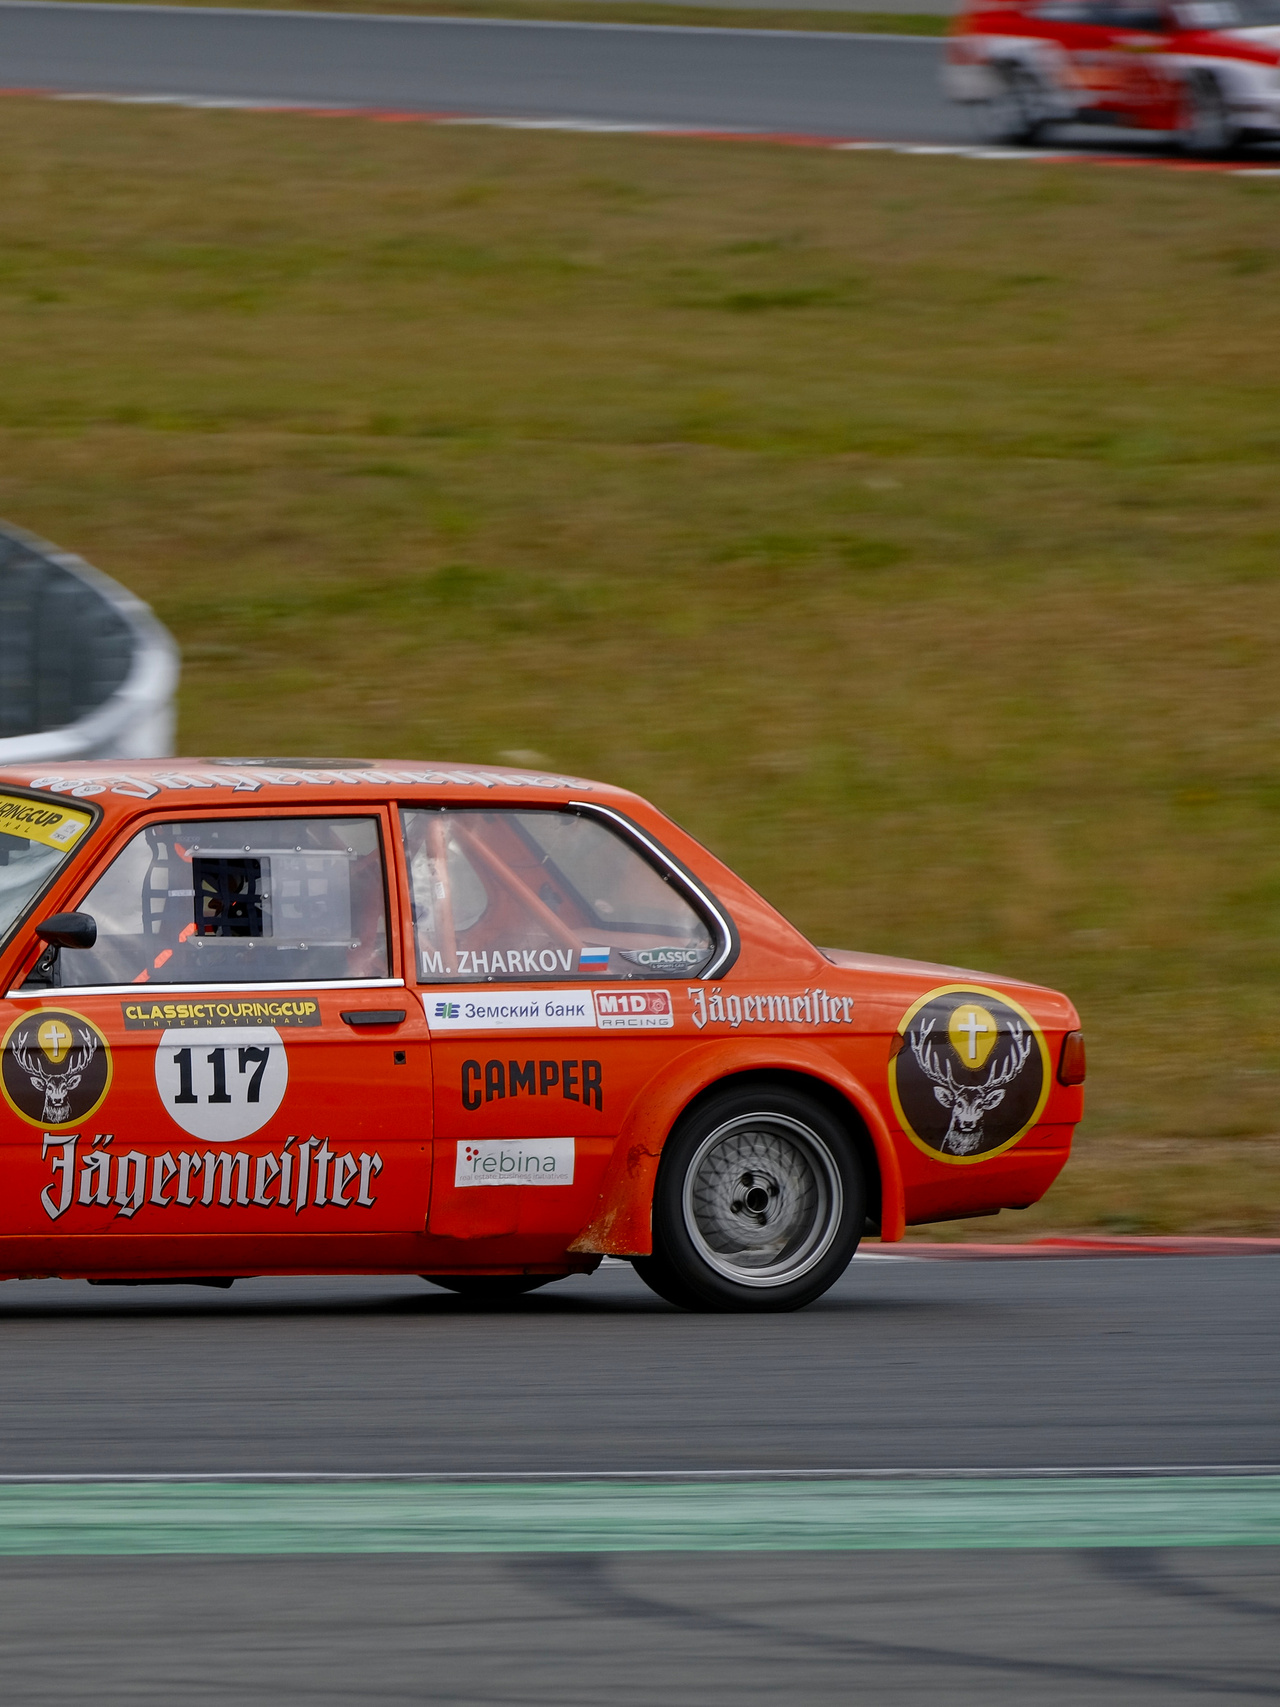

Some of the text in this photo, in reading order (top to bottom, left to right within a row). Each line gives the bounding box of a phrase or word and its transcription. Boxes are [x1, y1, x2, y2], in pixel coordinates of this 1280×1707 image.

[422, 949, 573, 974] M. ZHARKOV
[638, 951, 696, 964] CLASSIC
[125, 1002, 317, 1020] CLASSICTOURINGCUP
[465, 1000, 585, 1019] Земский банк
[600, 995, 647, 1013] M1D
[143, 1017, 304, 1027] INTERNATIONAL
[602, 1018, 669, 1027] RACING
[173, 1046, 270, 1104] 117
[461, 1060, 603, 1113] CAMPER
[473, 1151, 556, 1173] rebina
[459, 1174, 473, 1182] real
[474, 1173, 497, 1181] estate
[498, 1172, 532, 1180] business
